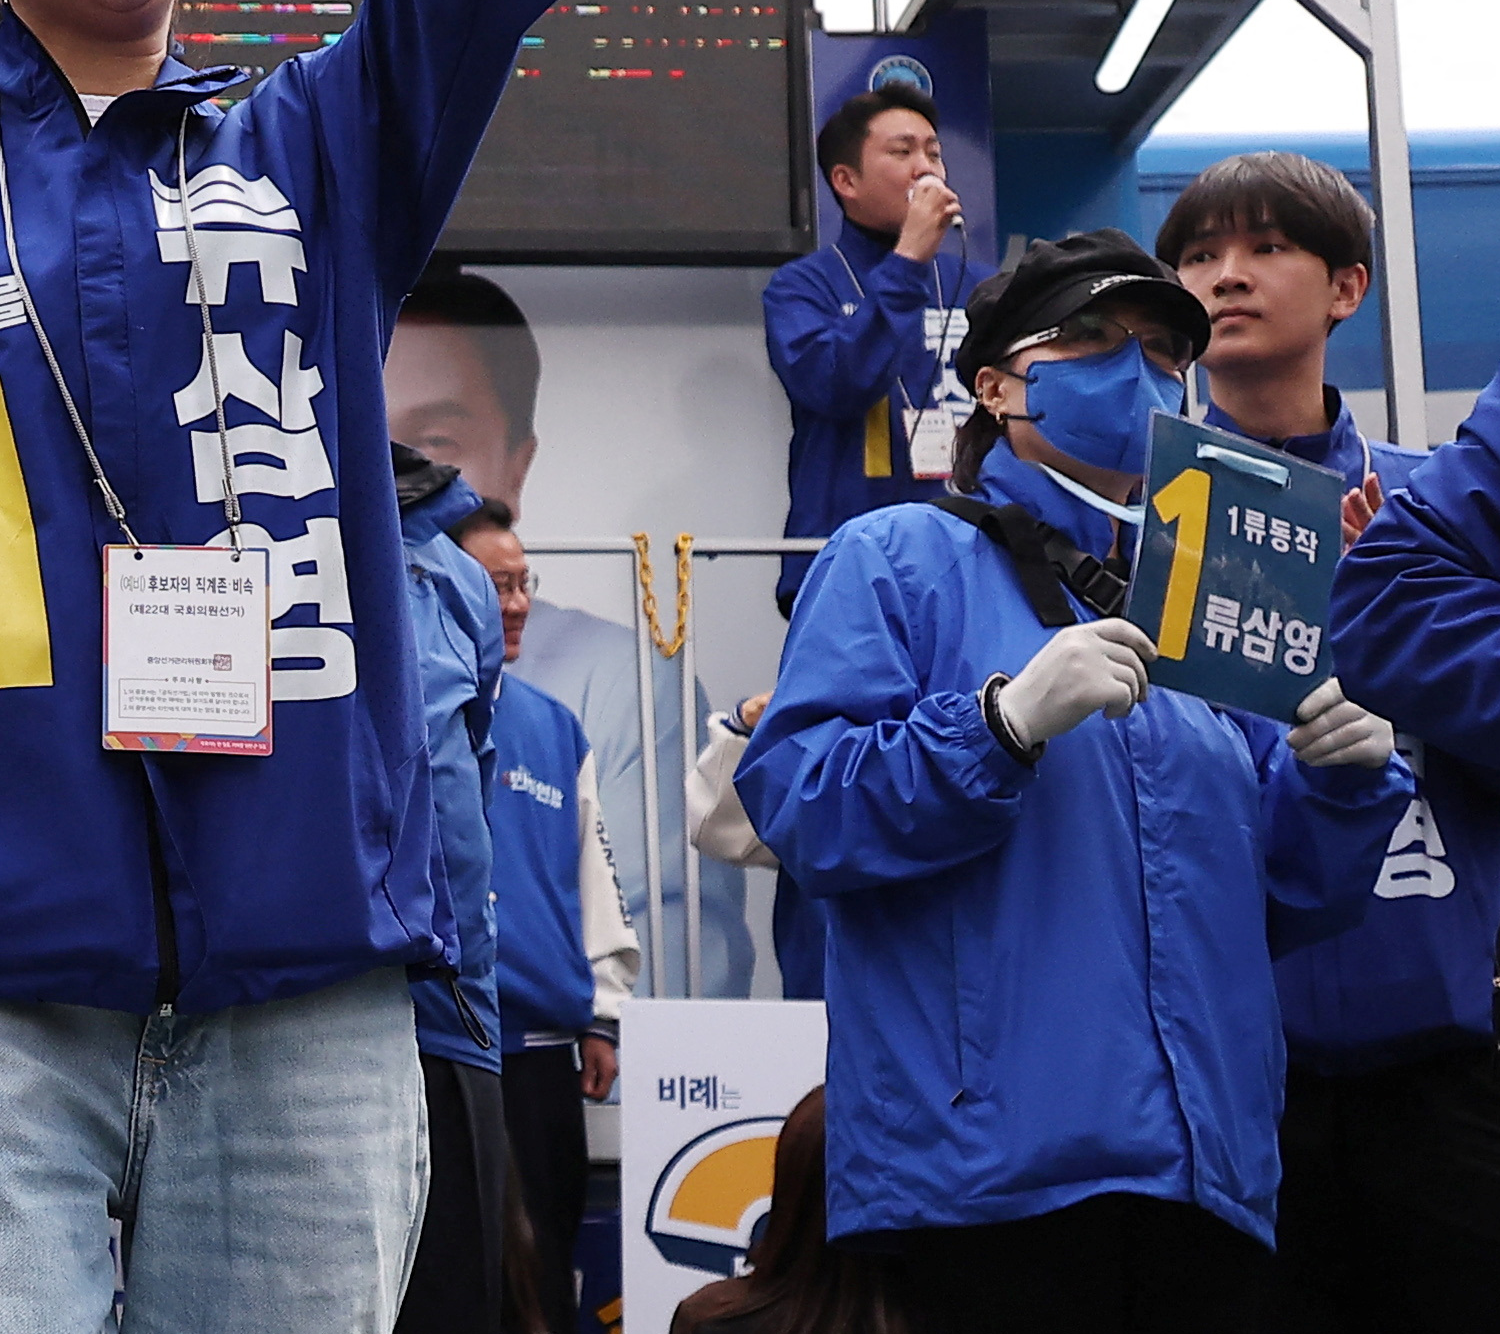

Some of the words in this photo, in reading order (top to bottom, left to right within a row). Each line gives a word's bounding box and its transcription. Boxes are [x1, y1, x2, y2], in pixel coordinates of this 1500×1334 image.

[148, 164, 358, 702] 류삼영
[1152, 468, 1212, 661] 1
[1227, 505, 1319, 564] 1류동작
[1202, 593, 1322, 676] 류삼영
[658, 1074, 742, 1111] 비례는
